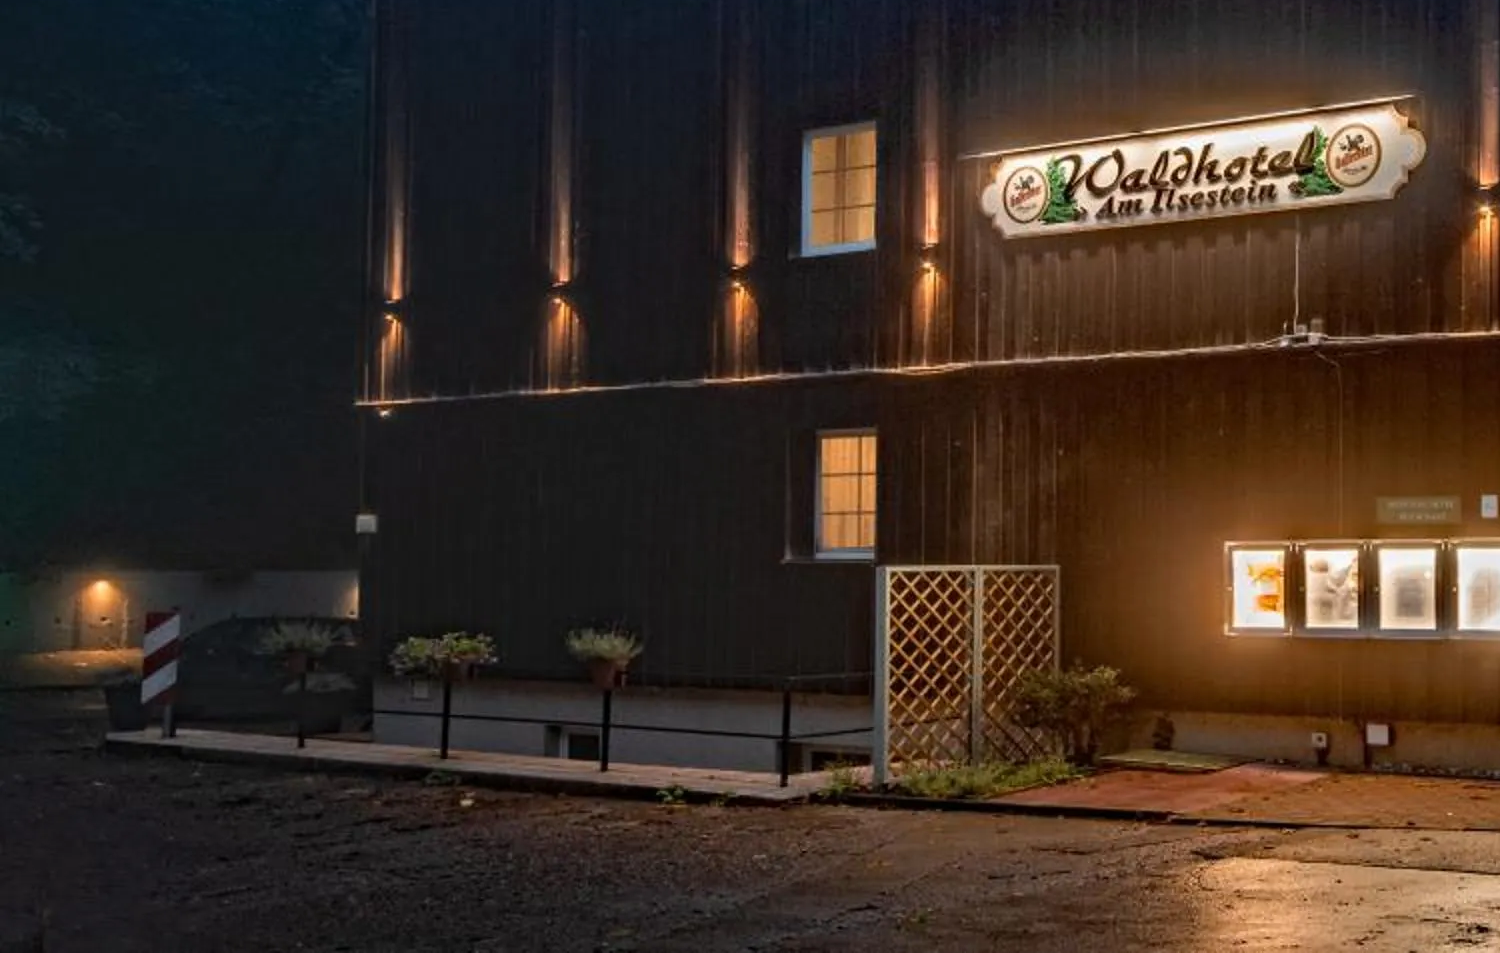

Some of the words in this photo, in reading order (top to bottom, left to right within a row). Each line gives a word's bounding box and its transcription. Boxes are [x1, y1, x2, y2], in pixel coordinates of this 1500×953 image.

[1054, 131, 1316, 198] Waldhotel
[1095, 195, 1143, 219] Am
[1150, 179, 1277, 214] Ilsestein
